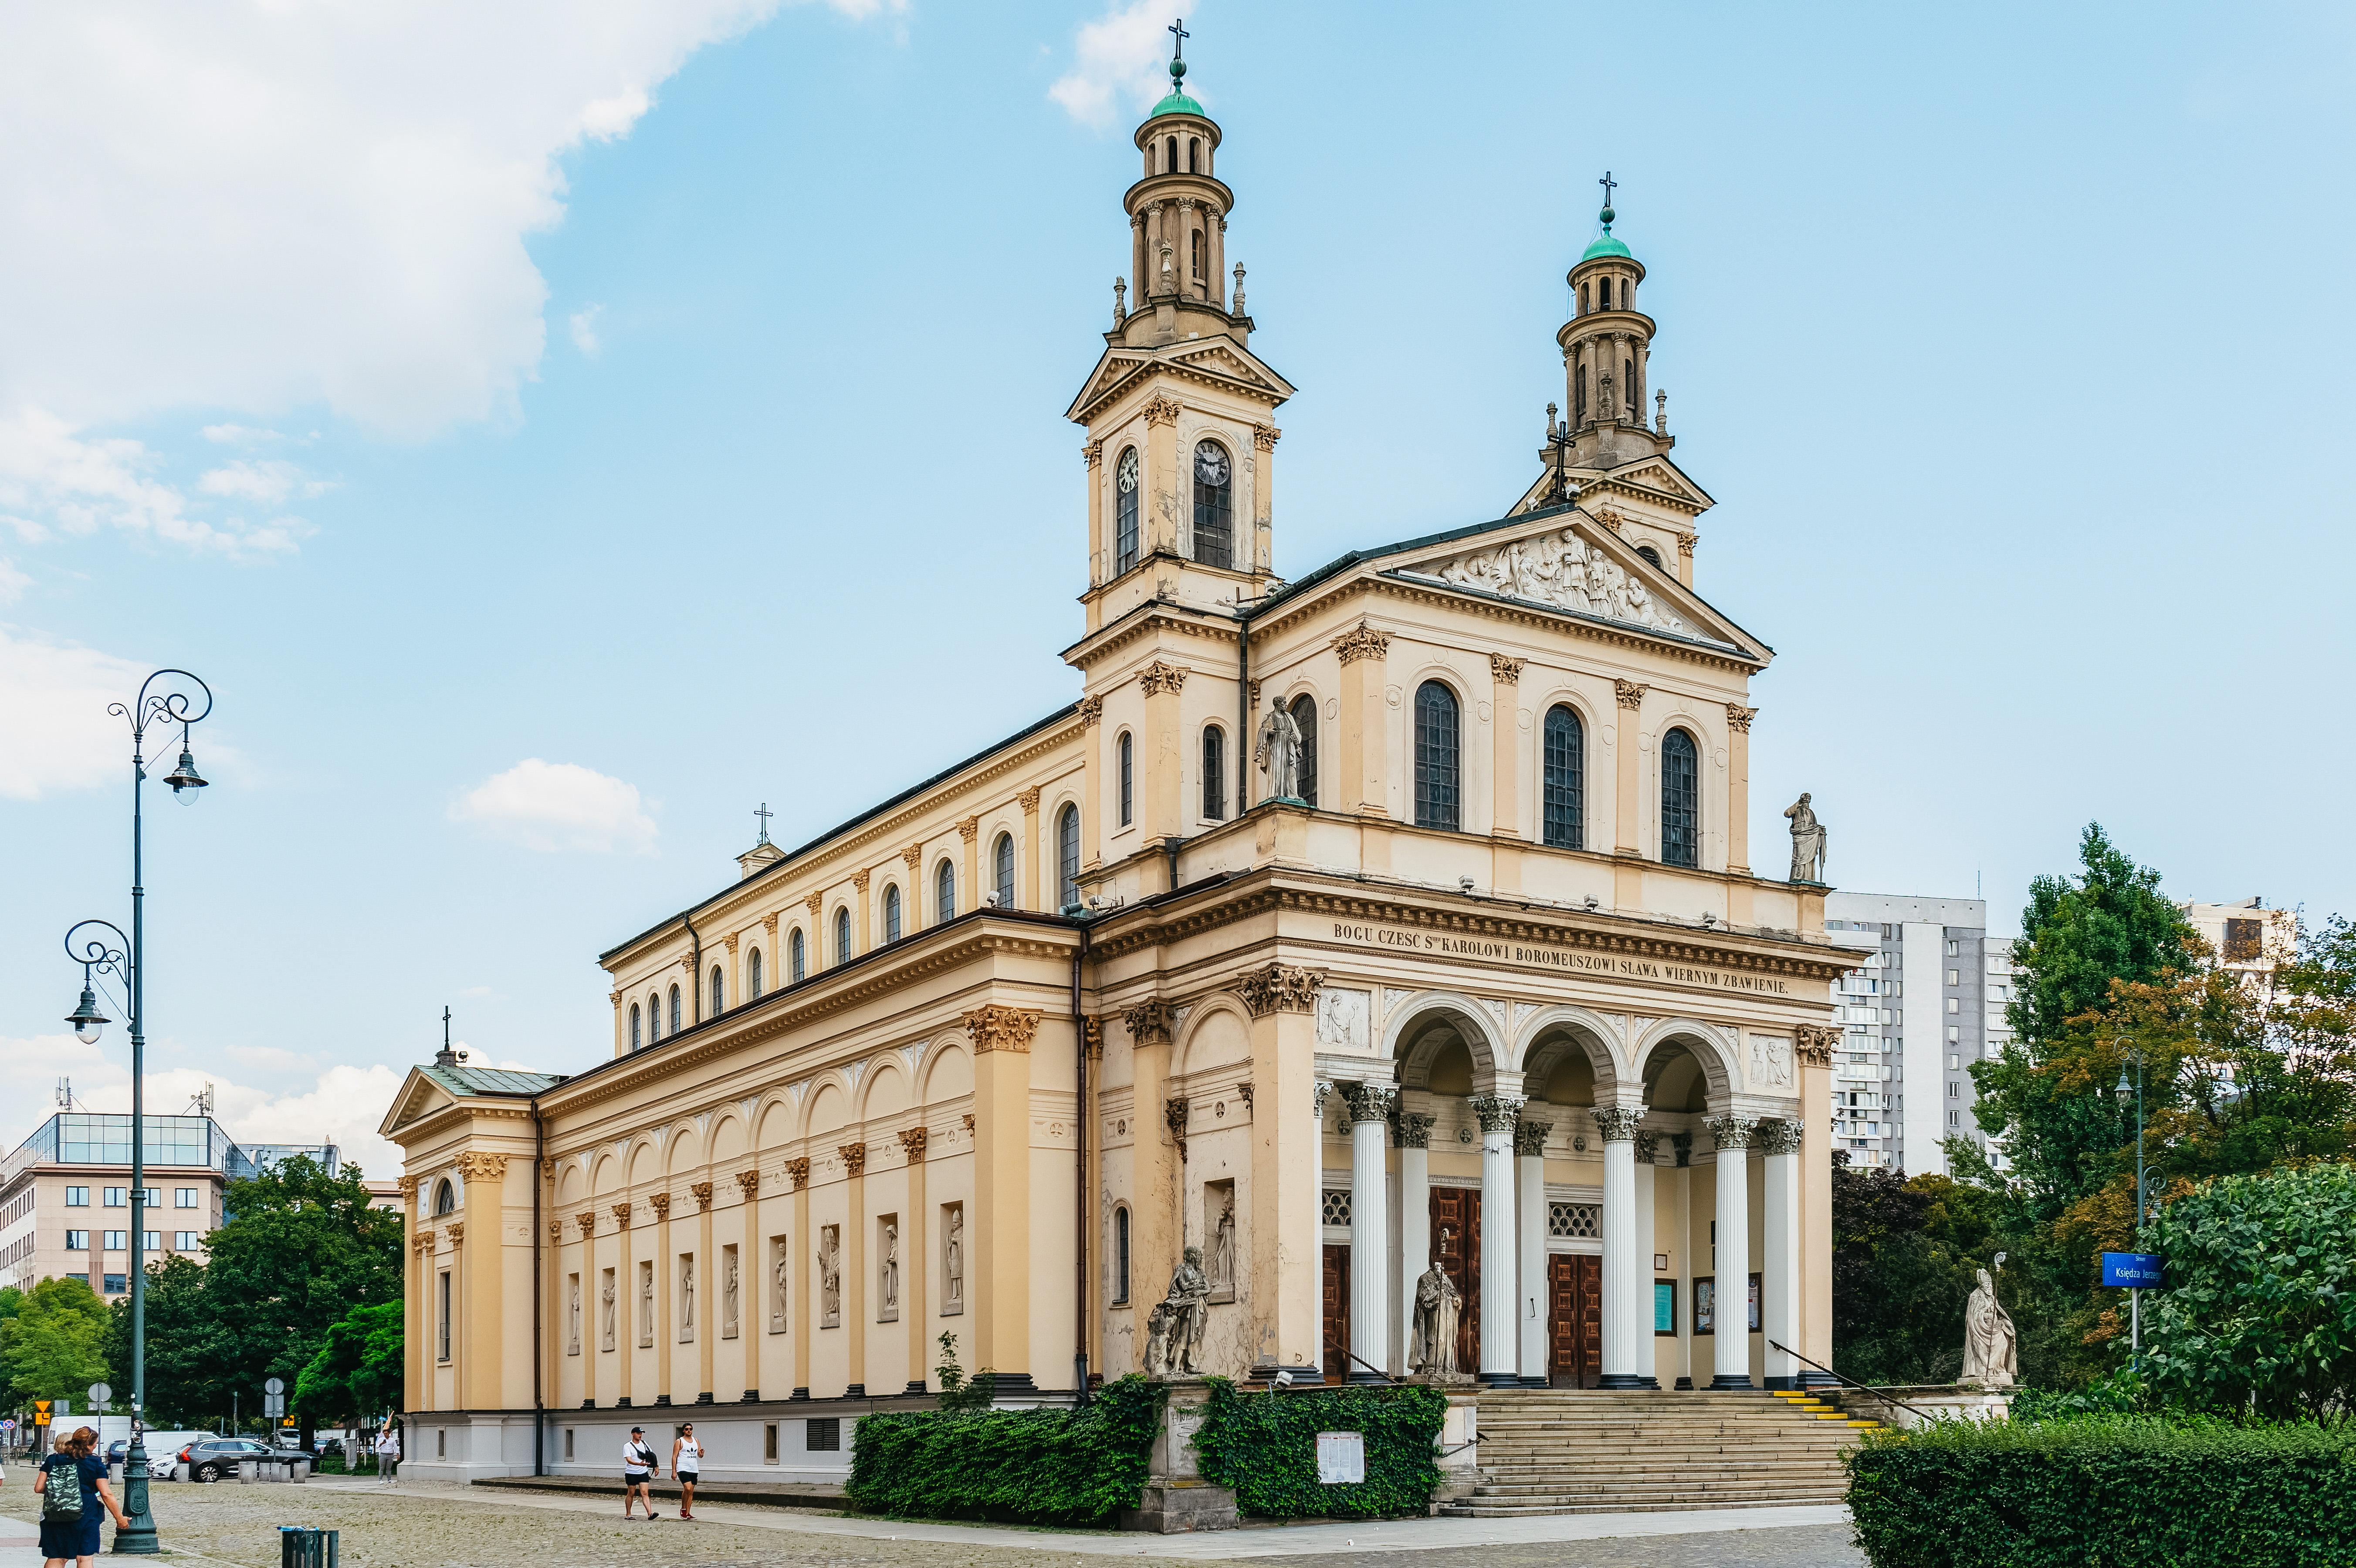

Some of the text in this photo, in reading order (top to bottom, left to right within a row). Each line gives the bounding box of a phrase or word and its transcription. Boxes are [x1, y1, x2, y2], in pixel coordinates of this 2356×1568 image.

[1334, 923, 1372, 941] BOGU
[1442, 937, 1509, 959] KAROLOWI
[1516, 947, 1615, 972] BOROMEUSZOWI
[1621, 961, 1659, 977] SŁAWA
[1665, 966, 1717, 985] WIERNYM
[1723, 974, 1788, 994] ZBAWIENIE.
[2116, 1267, 2162, 1281] Księdza Jerzego
